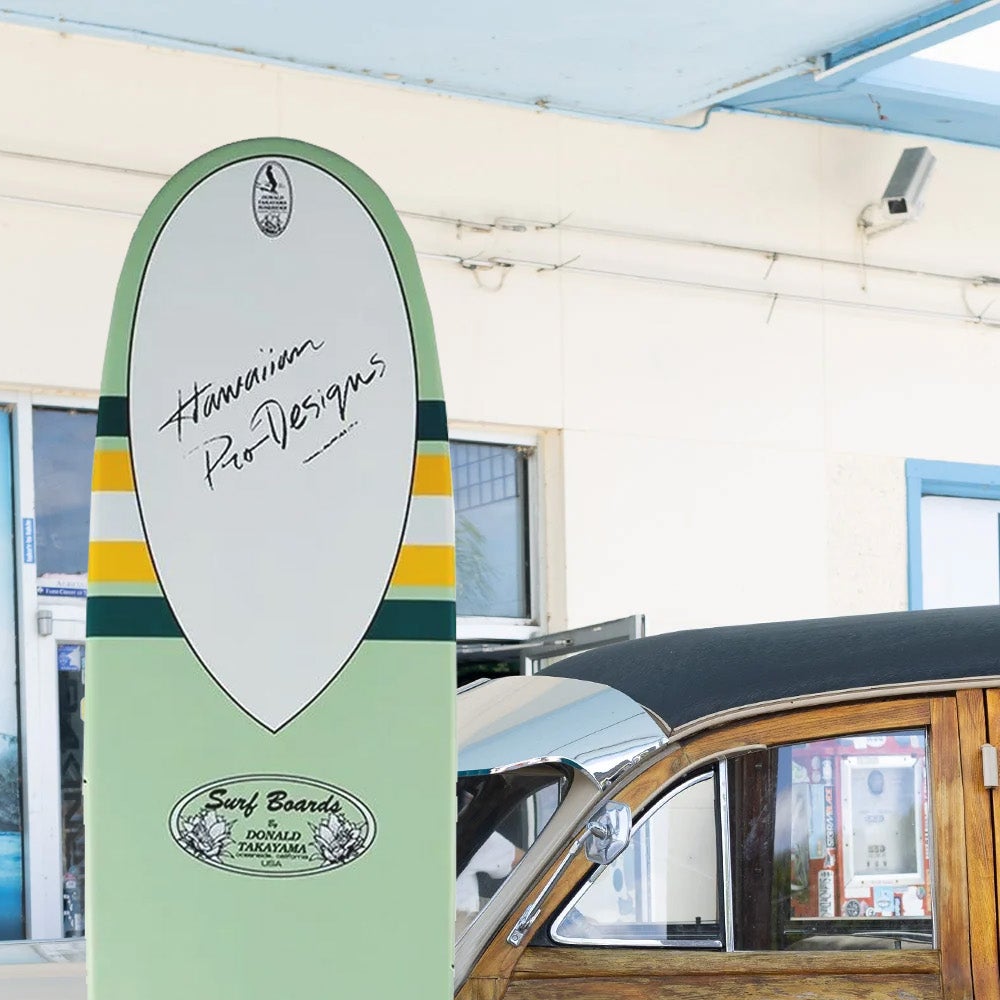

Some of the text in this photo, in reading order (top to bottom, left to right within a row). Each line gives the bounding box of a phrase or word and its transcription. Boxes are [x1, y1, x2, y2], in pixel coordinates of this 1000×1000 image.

[158, 339, 325, 442] Hawaiian
[205, 789, 342, 817] Surf Boards
[246, 830, 302, 842] DONALD
[238, 842, 307, 854] TAKAYAMA
[261, 860, 282, 868] USA
